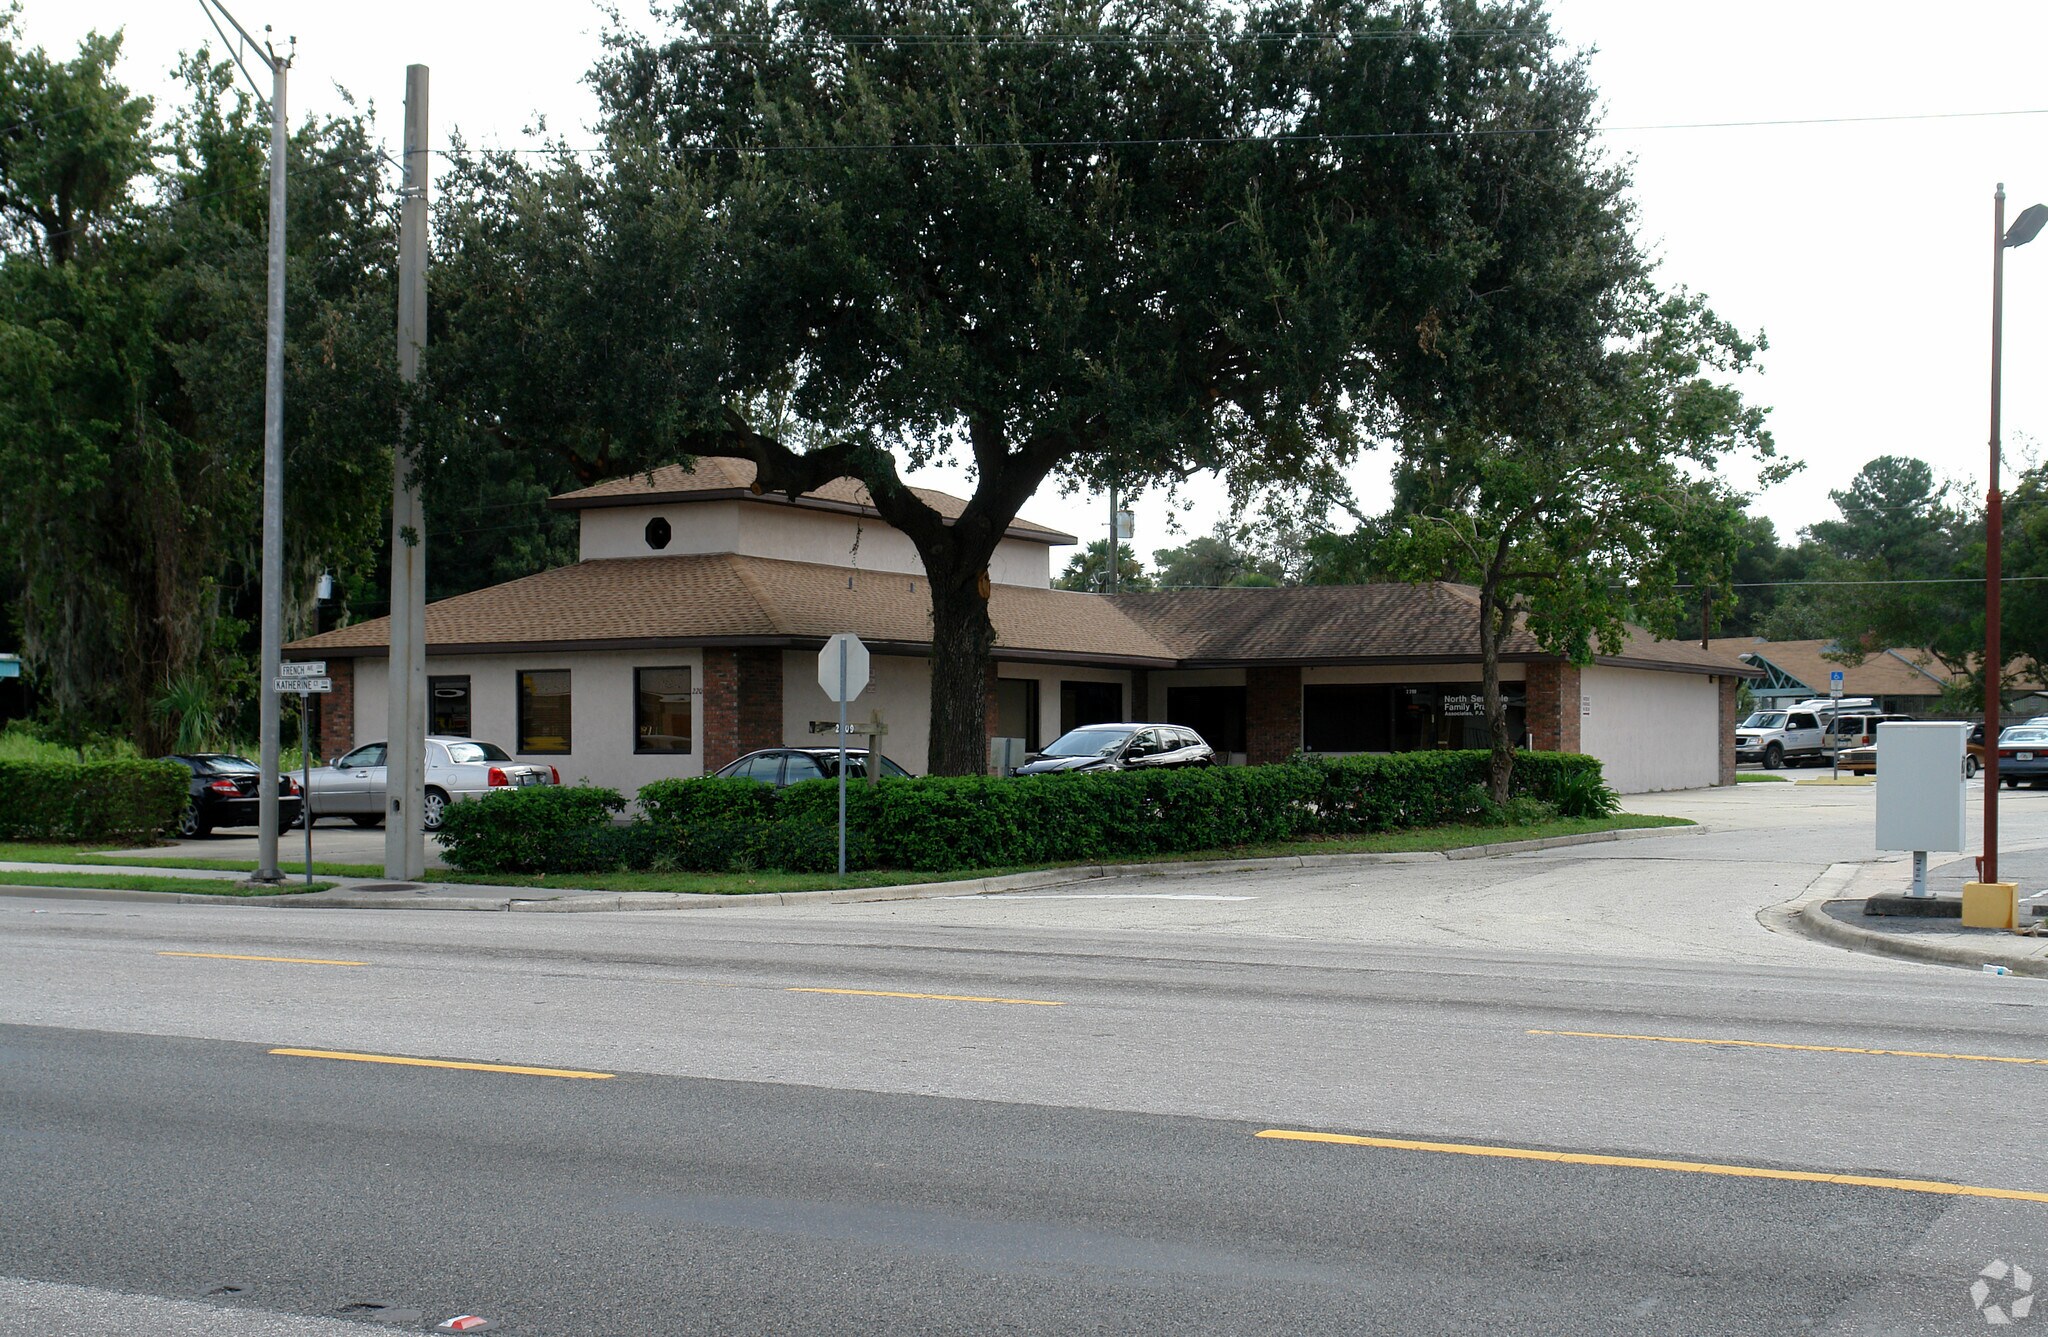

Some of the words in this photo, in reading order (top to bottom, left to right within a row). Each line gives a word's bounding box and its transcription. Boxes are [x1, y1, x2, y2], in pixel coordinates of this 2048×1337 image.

[283, 666, 304, 675] FRENCH
[276, 680, 312, 690] KATHERINE
[1444, 695, 1467, 703] North
[1470, 694, 1509, 703] Sele
[1444, 703, 1470, 712] Family
[835, 723, 854, 734] 209
